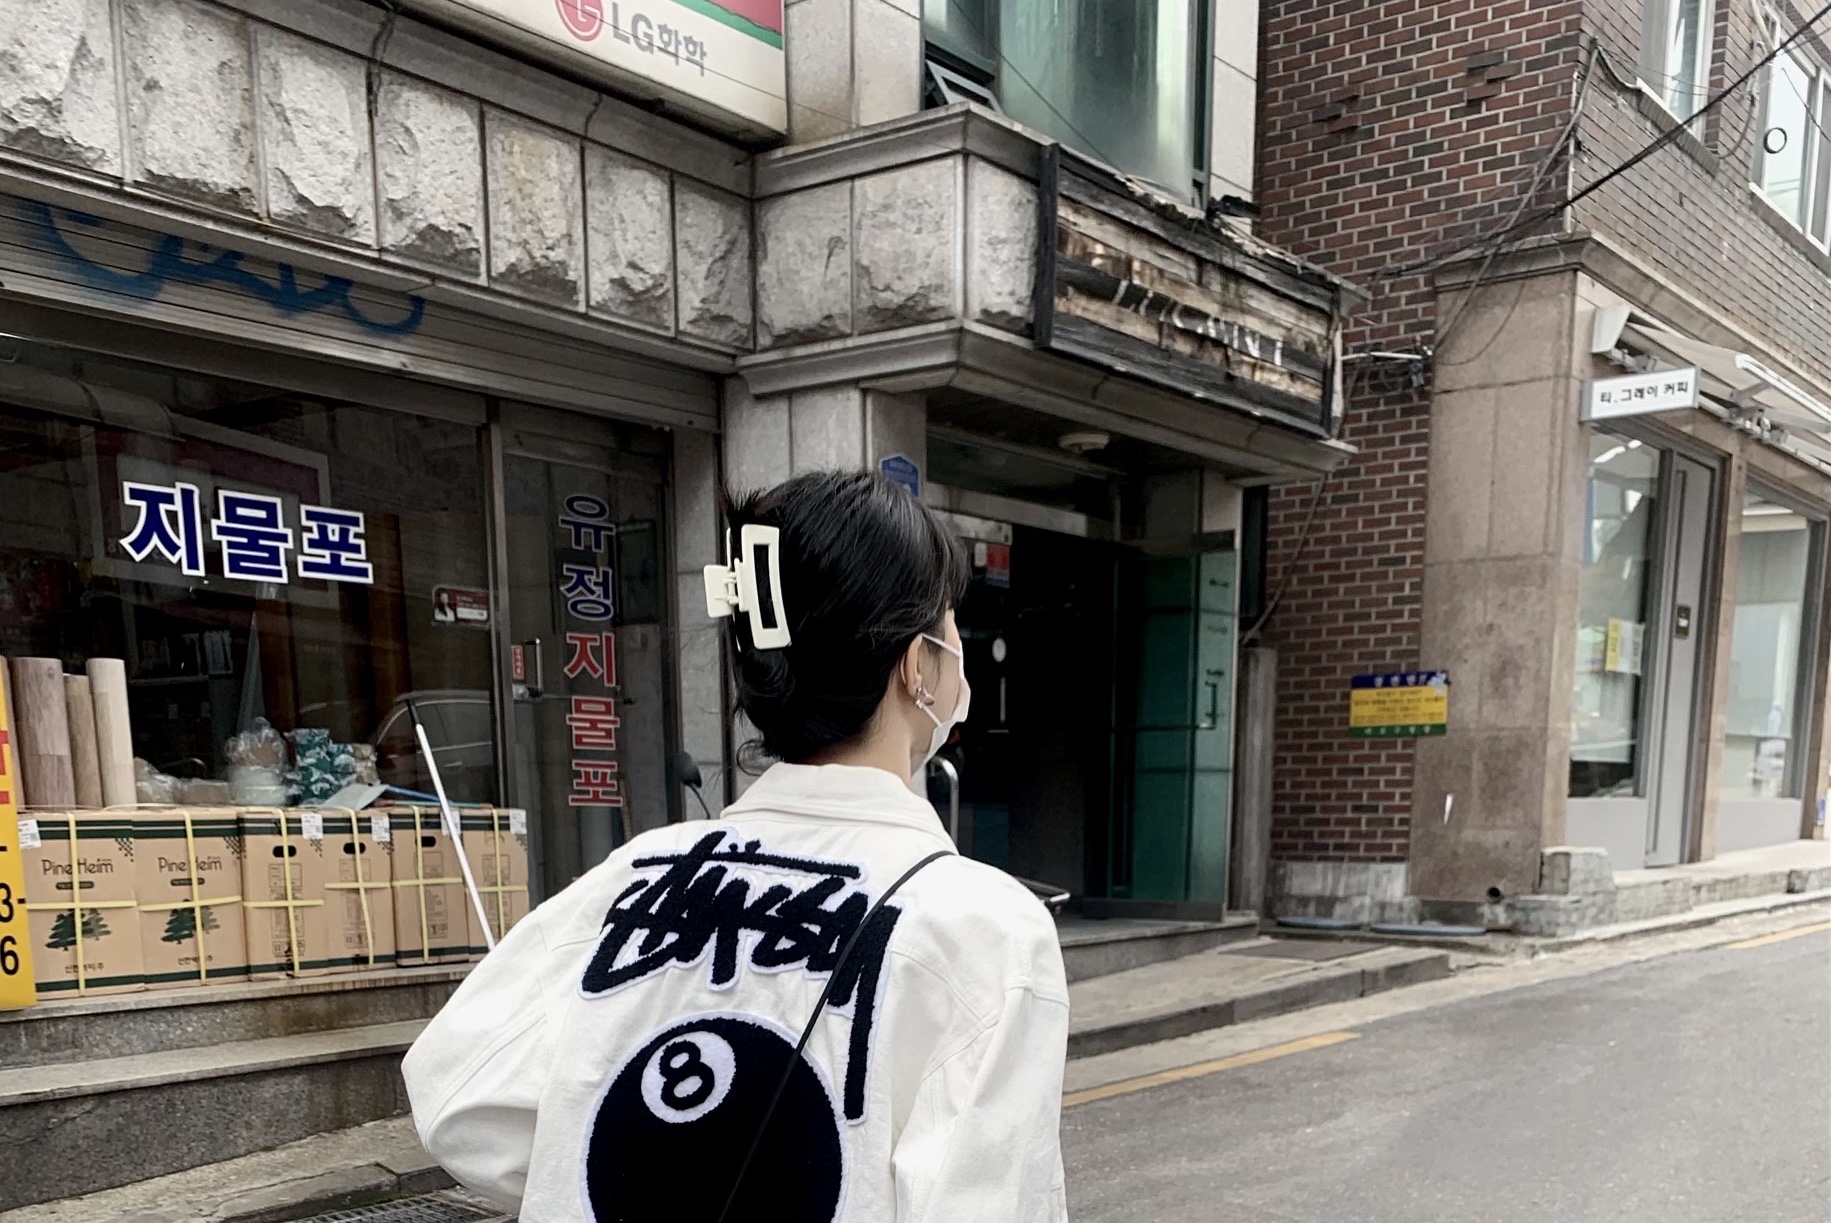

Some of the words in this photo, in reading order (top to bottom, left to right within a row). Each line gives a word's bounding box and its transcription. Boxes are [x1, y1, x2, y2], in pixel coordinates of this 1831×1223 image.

[612, 2, 708, 77] LG화학
[1664, 382, 1689, 395] 커피
[119, 481, 374, 584] 지물포
[658, 1040, 716, 1111] 8
